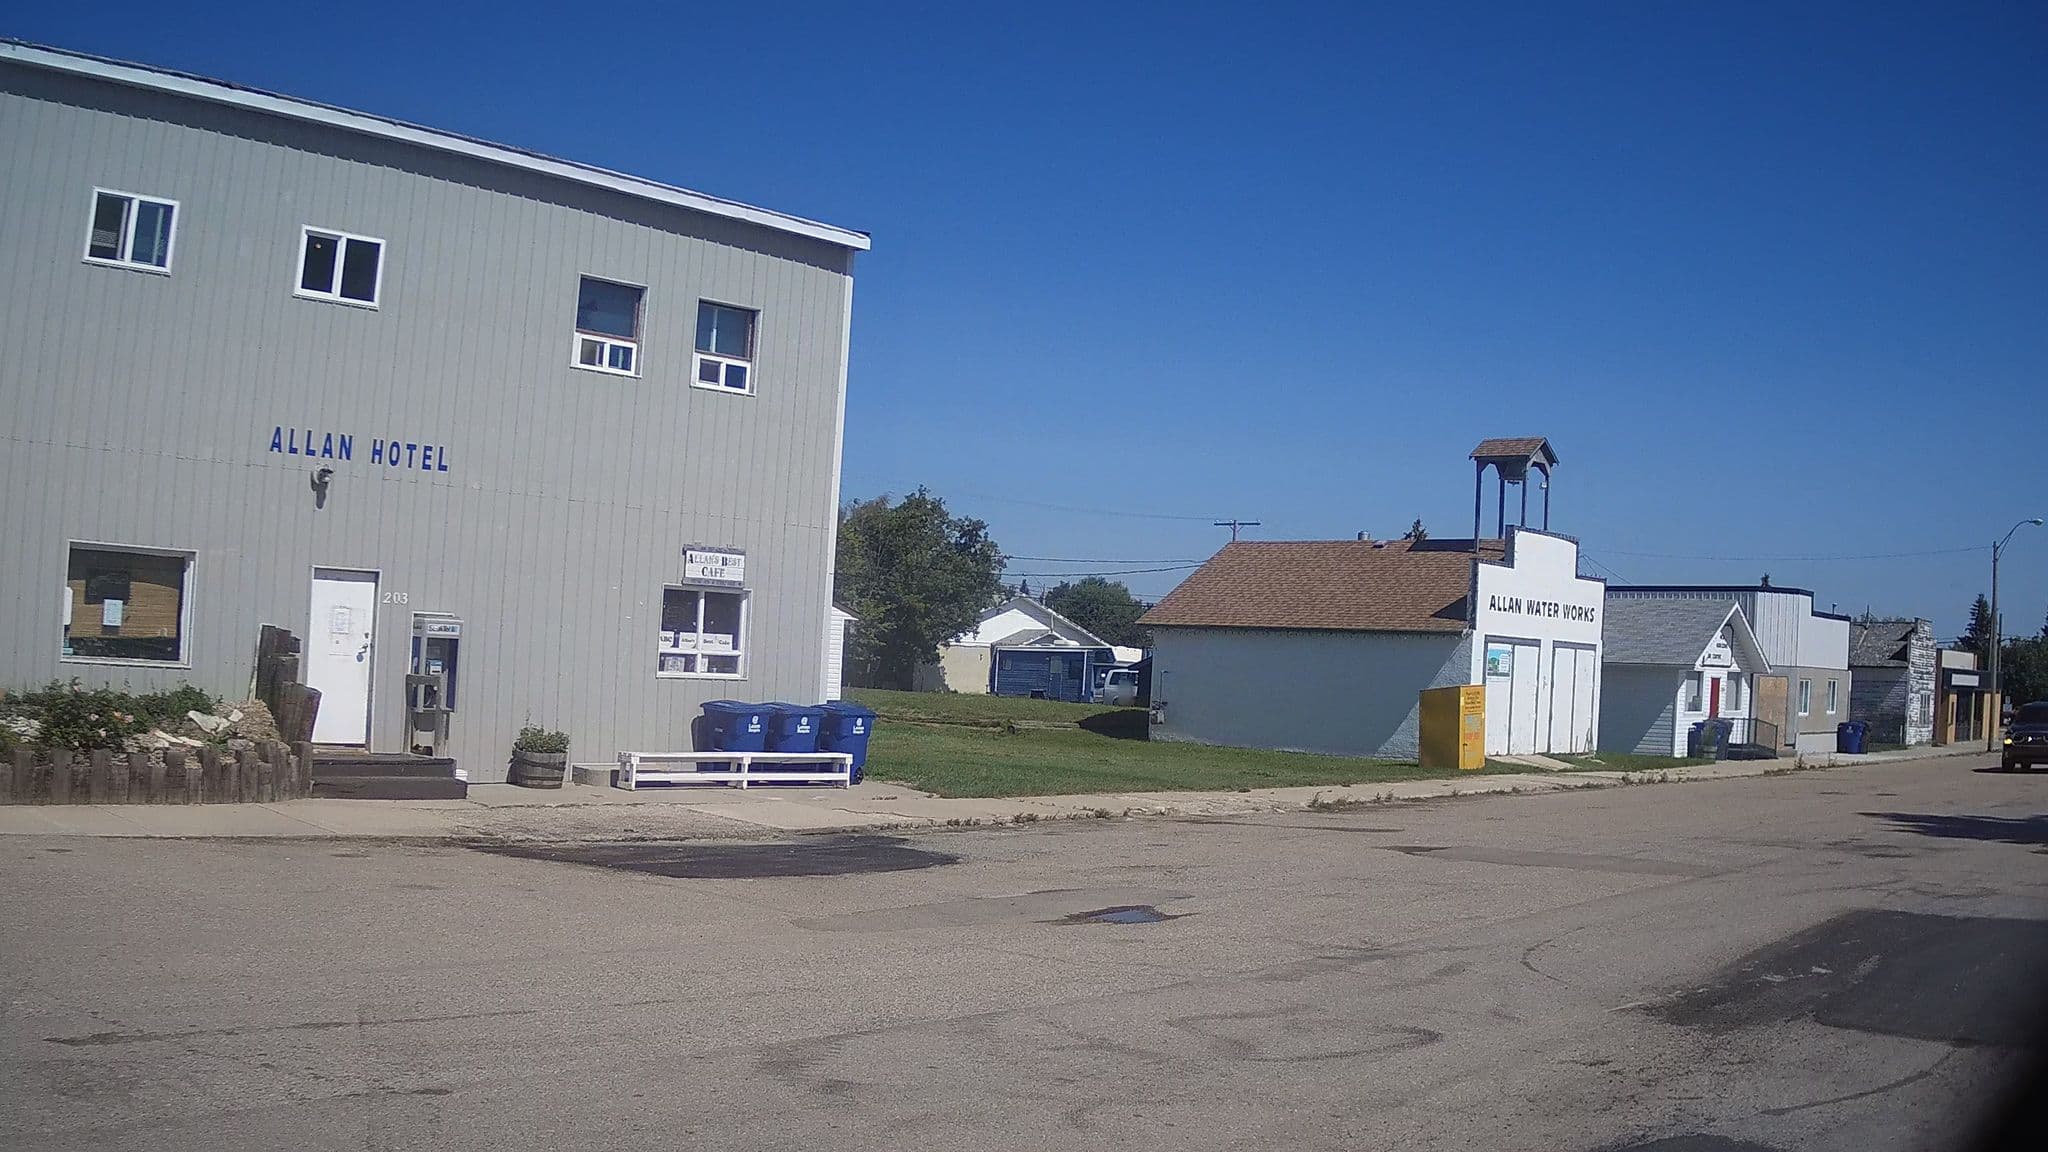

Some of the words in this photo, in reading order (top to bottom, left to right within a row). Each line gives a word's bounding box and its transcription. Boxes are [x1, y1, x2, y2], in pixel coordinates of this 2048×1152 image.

[270, 426, 353, 460] ALLAN
[371, 438, 448, 471] HOTEL
[701, 566, 726, 578] CAFE
[383, 592, 409, 604] 203
[1489, 595, 1522, 614] ALLAN
[1527, 600, 1559, 618] WATER
[1563, 604, 1595, 622] WORKS
